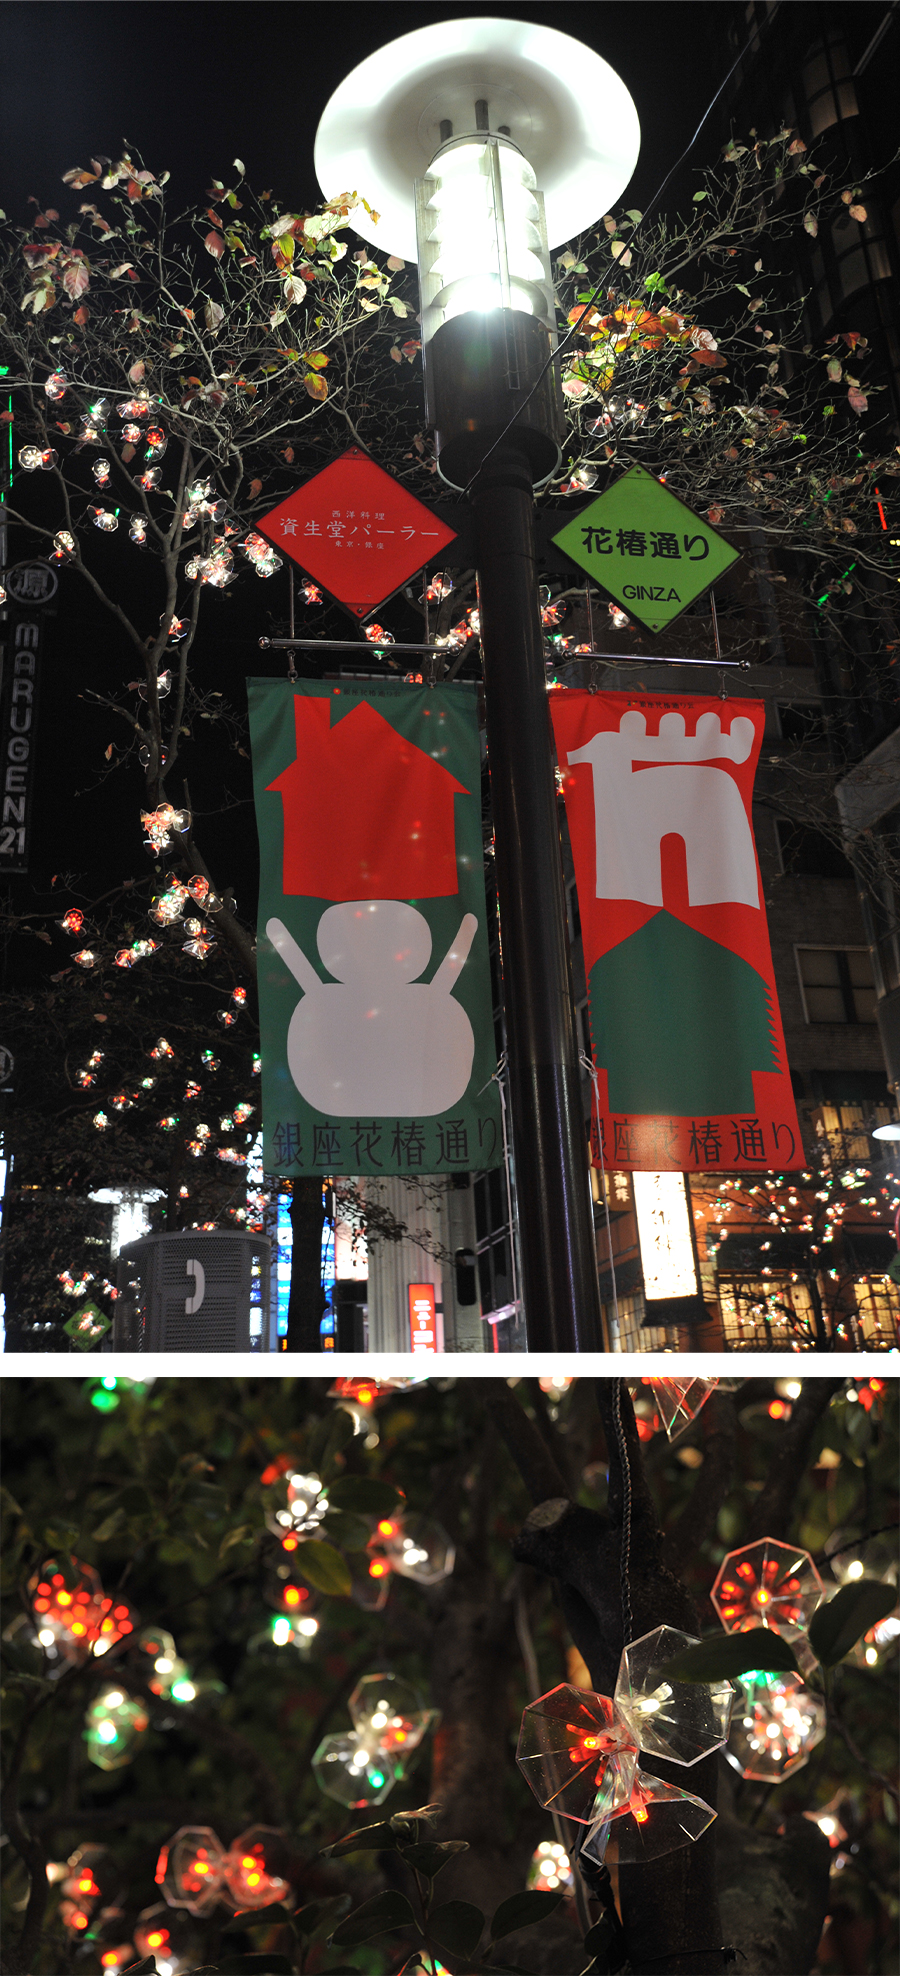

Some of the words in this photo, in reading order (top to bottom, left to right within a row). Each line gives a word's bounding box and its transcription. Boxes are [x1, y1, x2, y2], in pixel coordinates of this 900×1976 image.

[280, 518, 439, 541] 資生堂パーラー
[331, 510, 385, 521] 西洋料理
[580, 525, 710, 561] 花椿通り
[622, 584, 682, 603] GINZA
[3, 622, 39, 823] MARUGEN
[0, 826, 26, 855] 21
[272, 1117, 498, 1168] 銀座花椿通り
